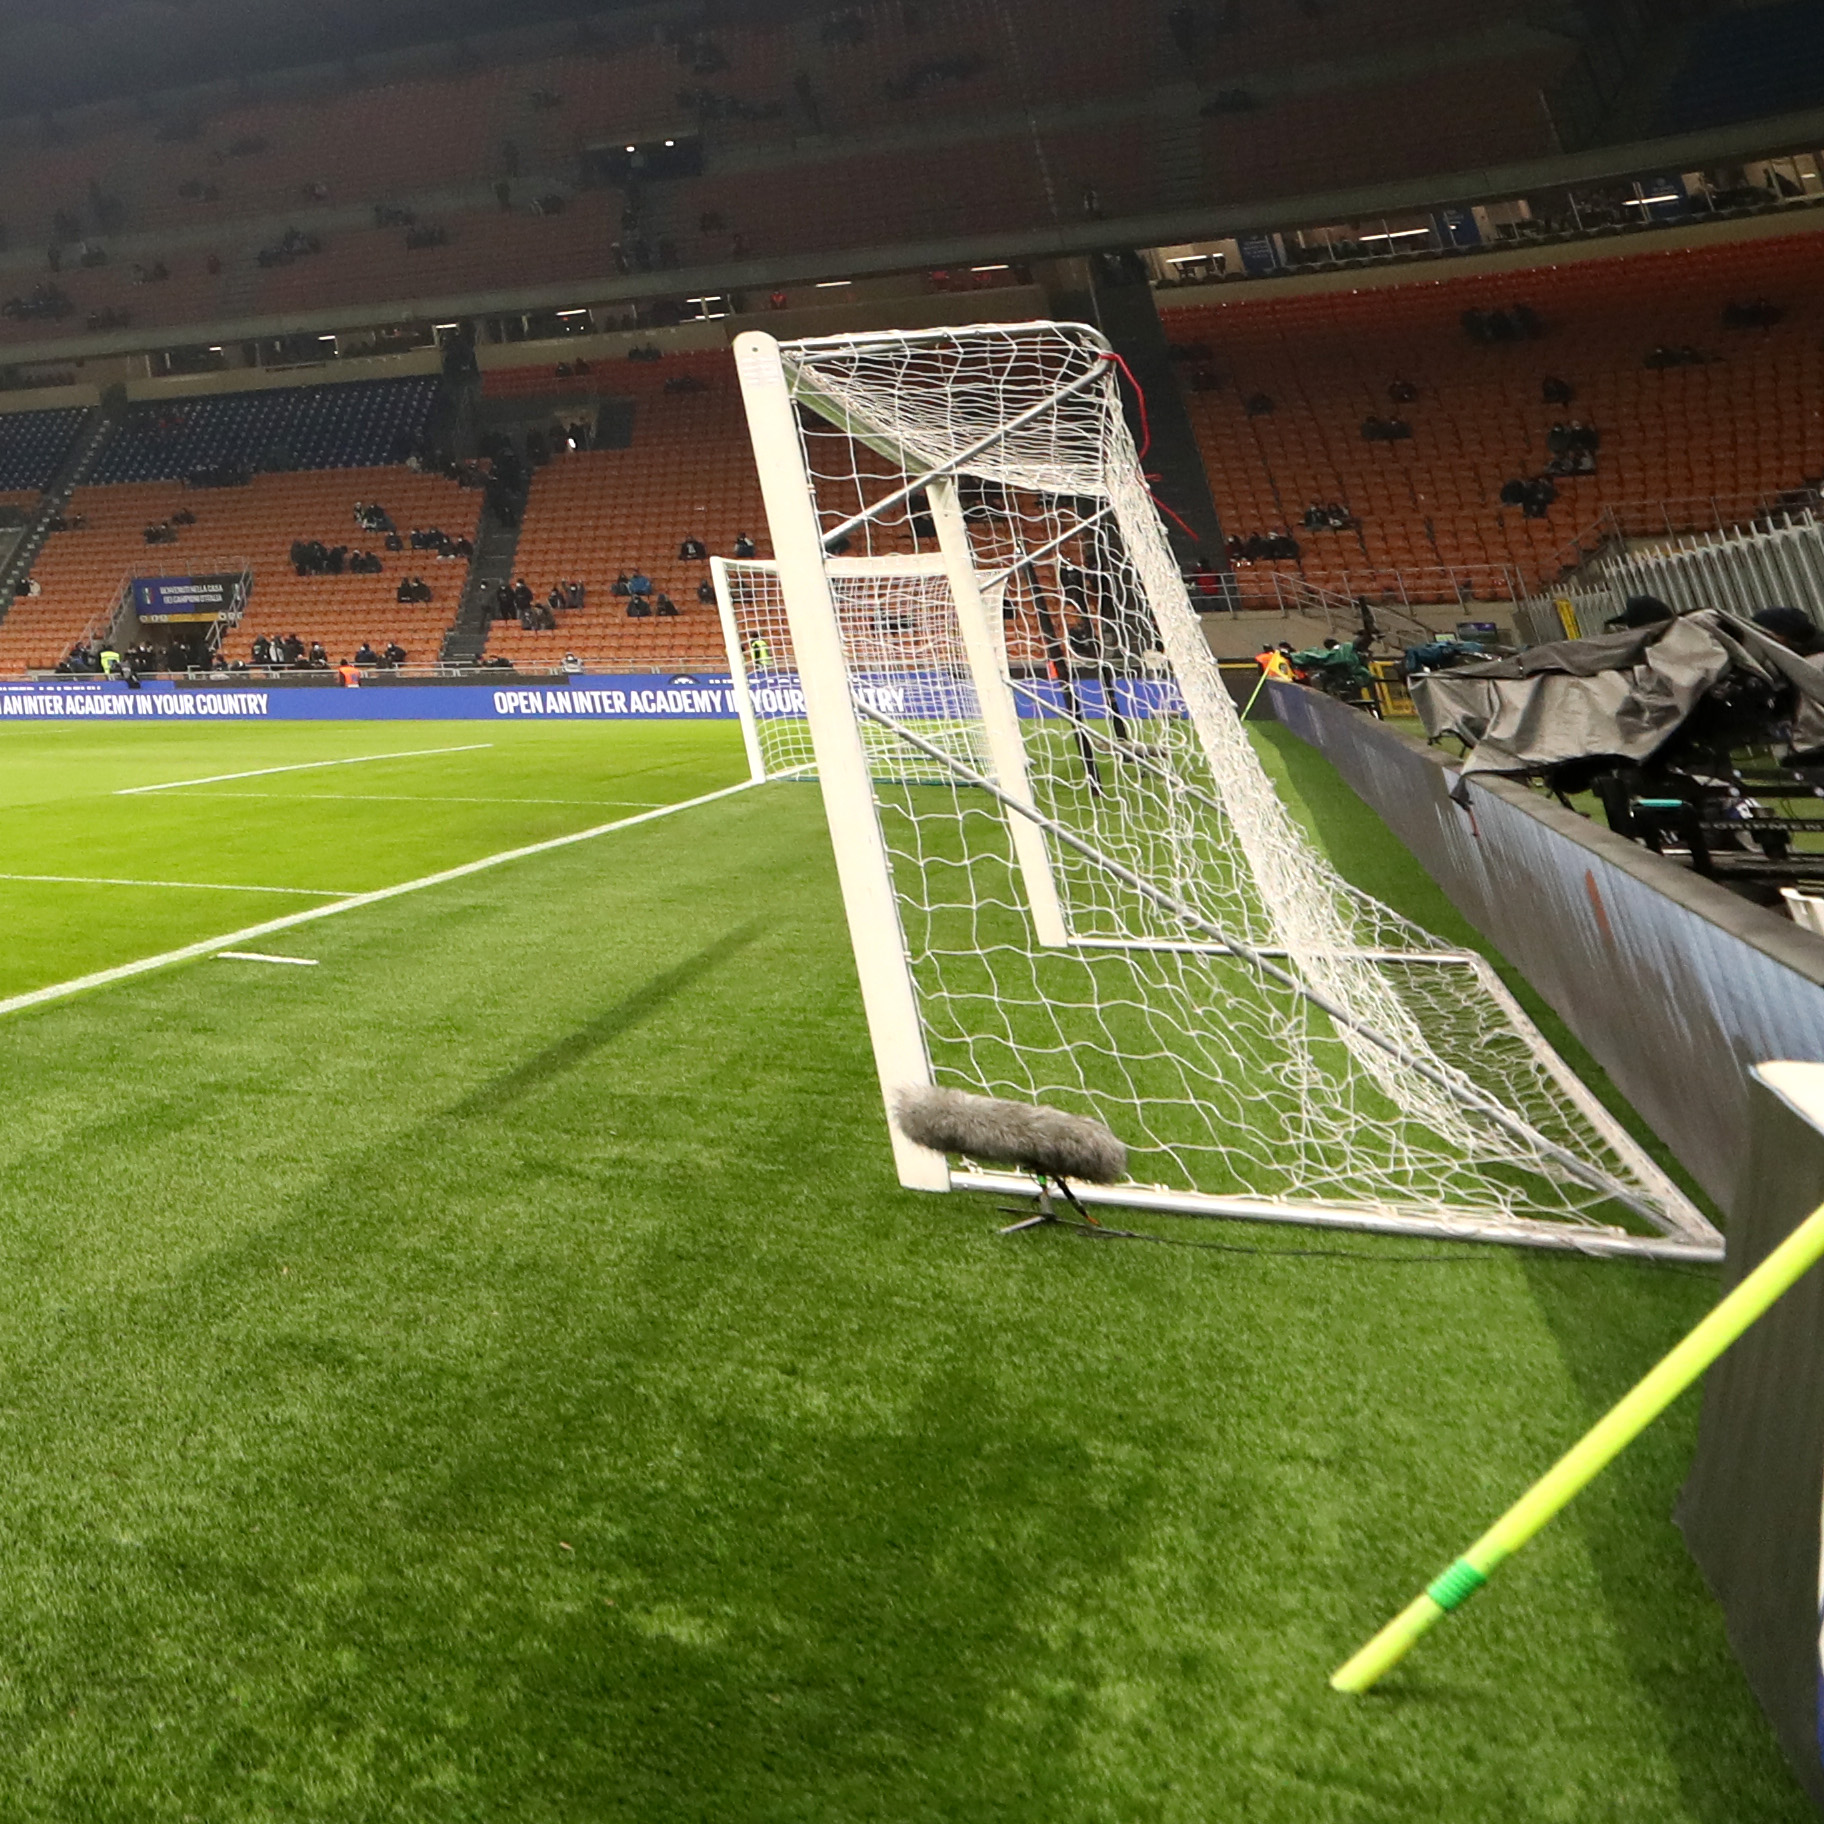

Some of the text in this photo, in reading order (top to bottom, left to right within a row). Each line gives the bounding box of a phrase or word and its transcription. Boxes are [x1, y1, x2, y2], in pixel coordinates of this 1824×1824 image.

[3, 695, 23, 715] AN
[23, 695, 64, 715] INTER
[65, 695, 136, 715] ACADEMY
[136, 694, 153, 715] IN
[152, 694, 195, 715] YOUR
[195, 694, 268, 715] COUNTRY
[493, 691, 544, 714] OPEN
[546, 691, 571, 713] AN
[571, 691, 628, 713] INTER
[630, 690, 723, 713] ACADEMY
[748, 689, 807, 713] YOUR
